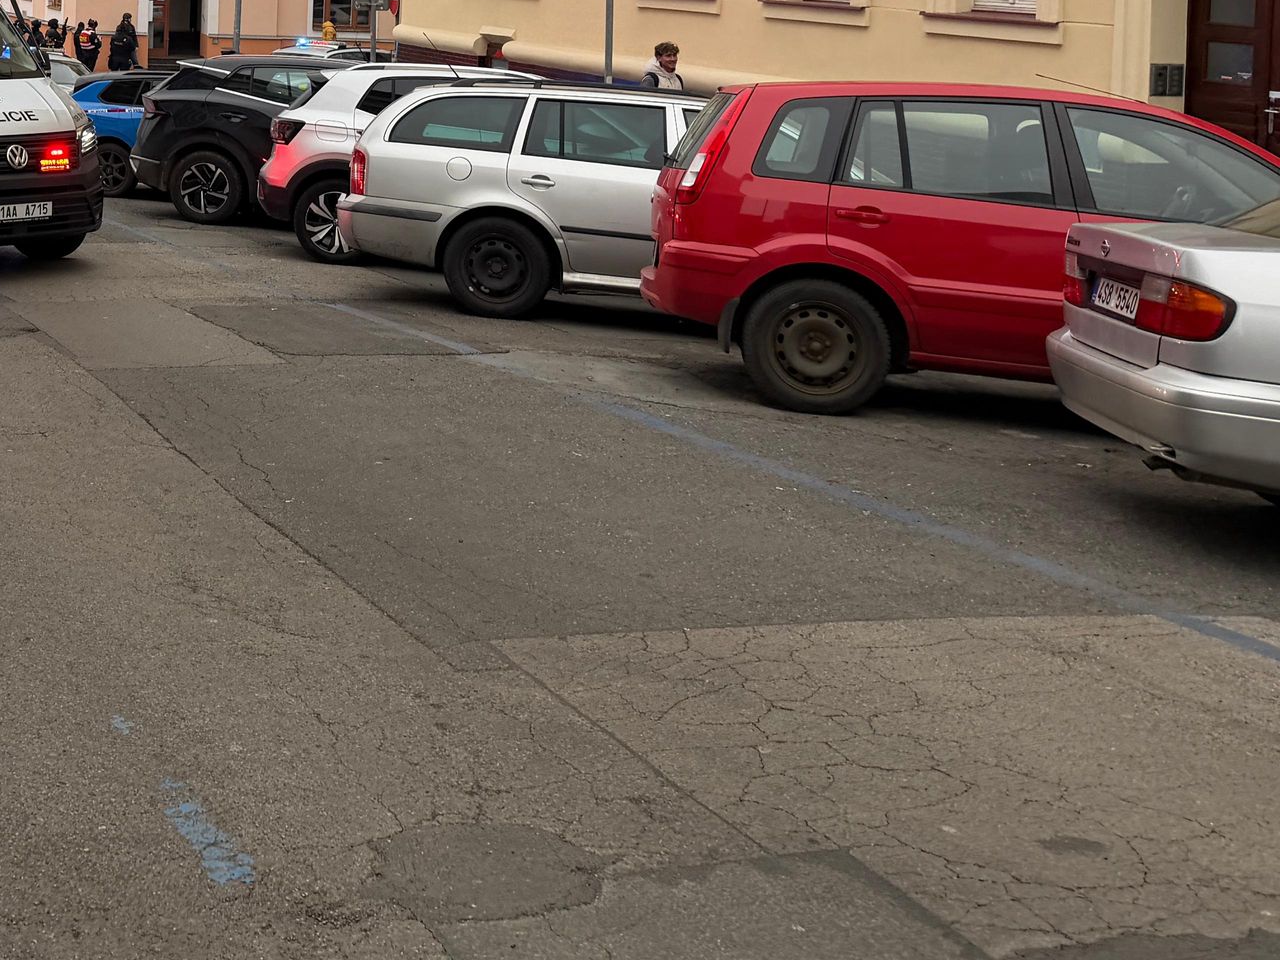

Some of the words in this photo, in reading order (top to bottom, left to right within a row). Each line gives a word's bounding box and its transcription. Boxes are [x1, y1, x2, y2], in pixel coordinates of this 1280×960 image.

[0, 205, 18, 219] 1AA
[25, 202, 48, 217] A715
[1098, 281, 1114, 305] 4S8
[1115, 286, 1138, 315] 5540
